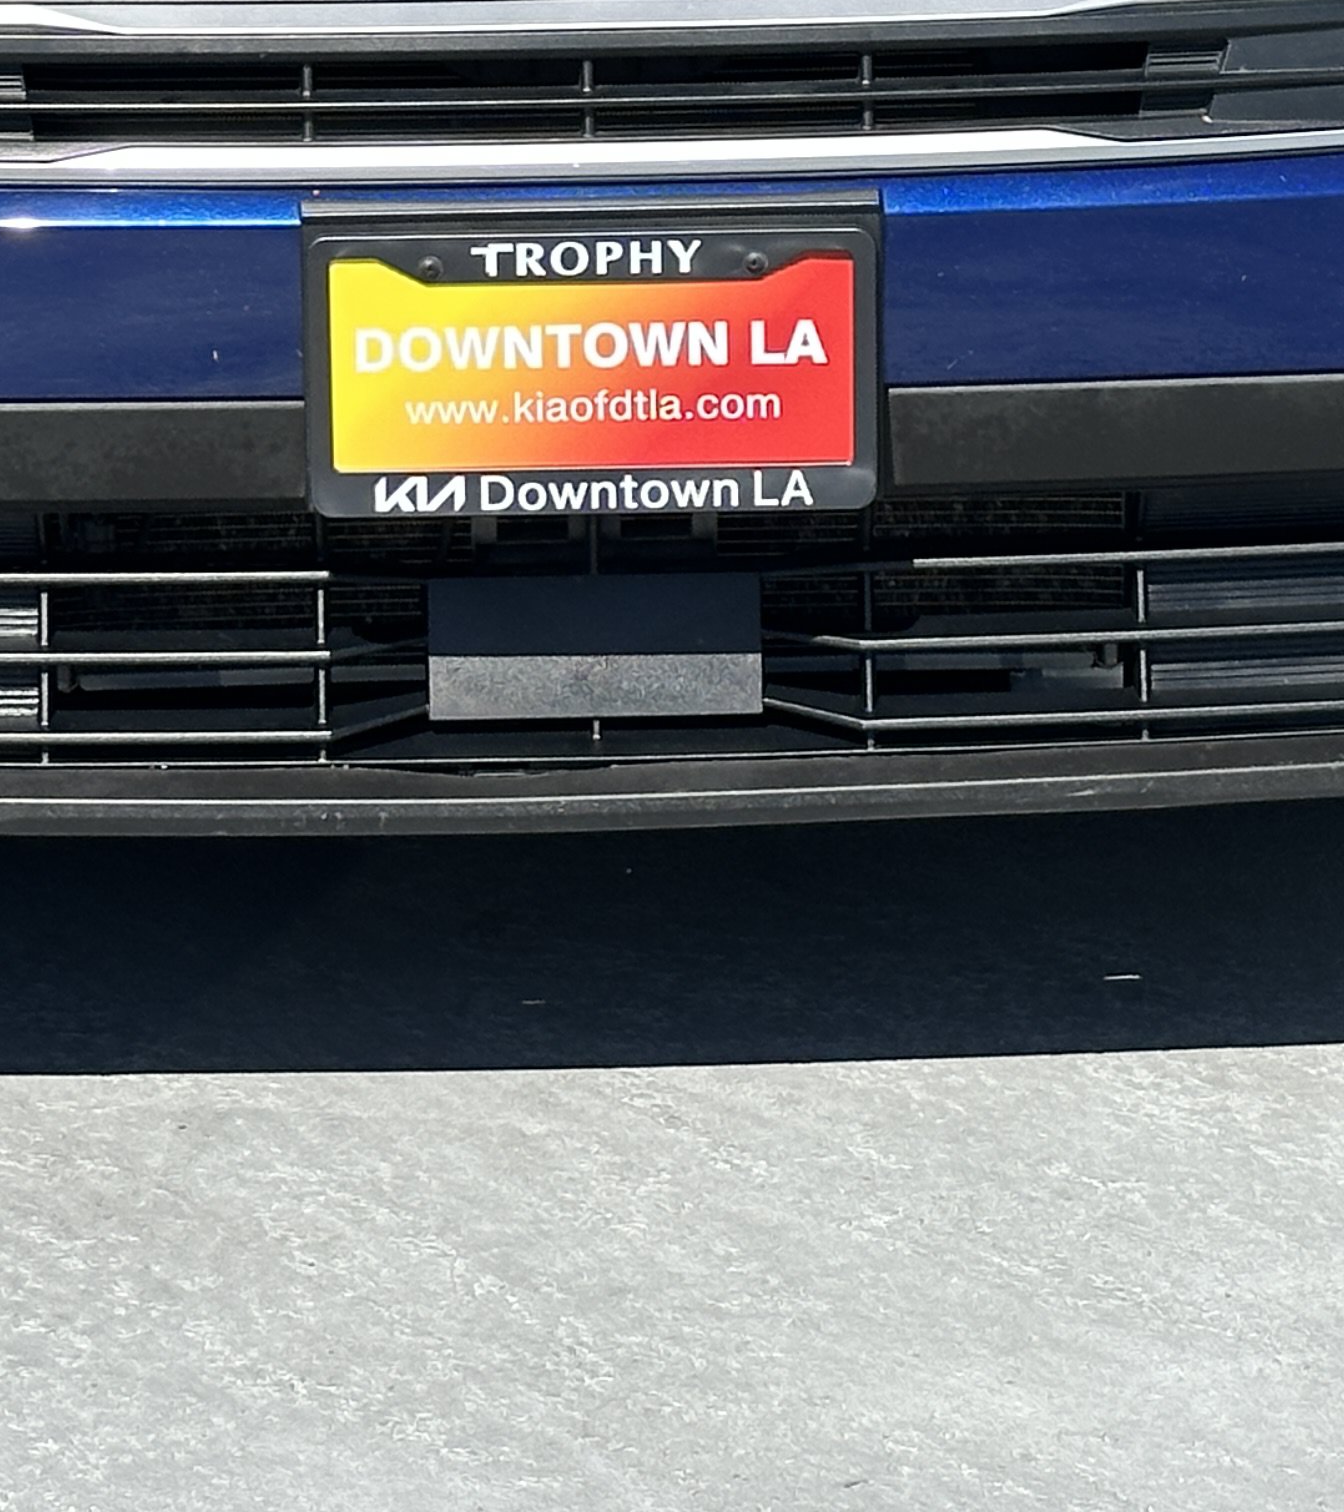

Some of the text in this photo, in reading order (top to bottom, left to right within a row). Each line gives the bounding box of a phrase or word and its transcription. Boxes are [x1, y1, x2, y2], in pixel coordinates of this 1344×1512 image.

[470, 239, 702, 277] TROPHY
[355, 319, 828, 373] DOWNTOWN LA
[404, 390, 782, 425] www.kiaofdtla.com
[374, 470, 814, 513] KIA Downtown LA
